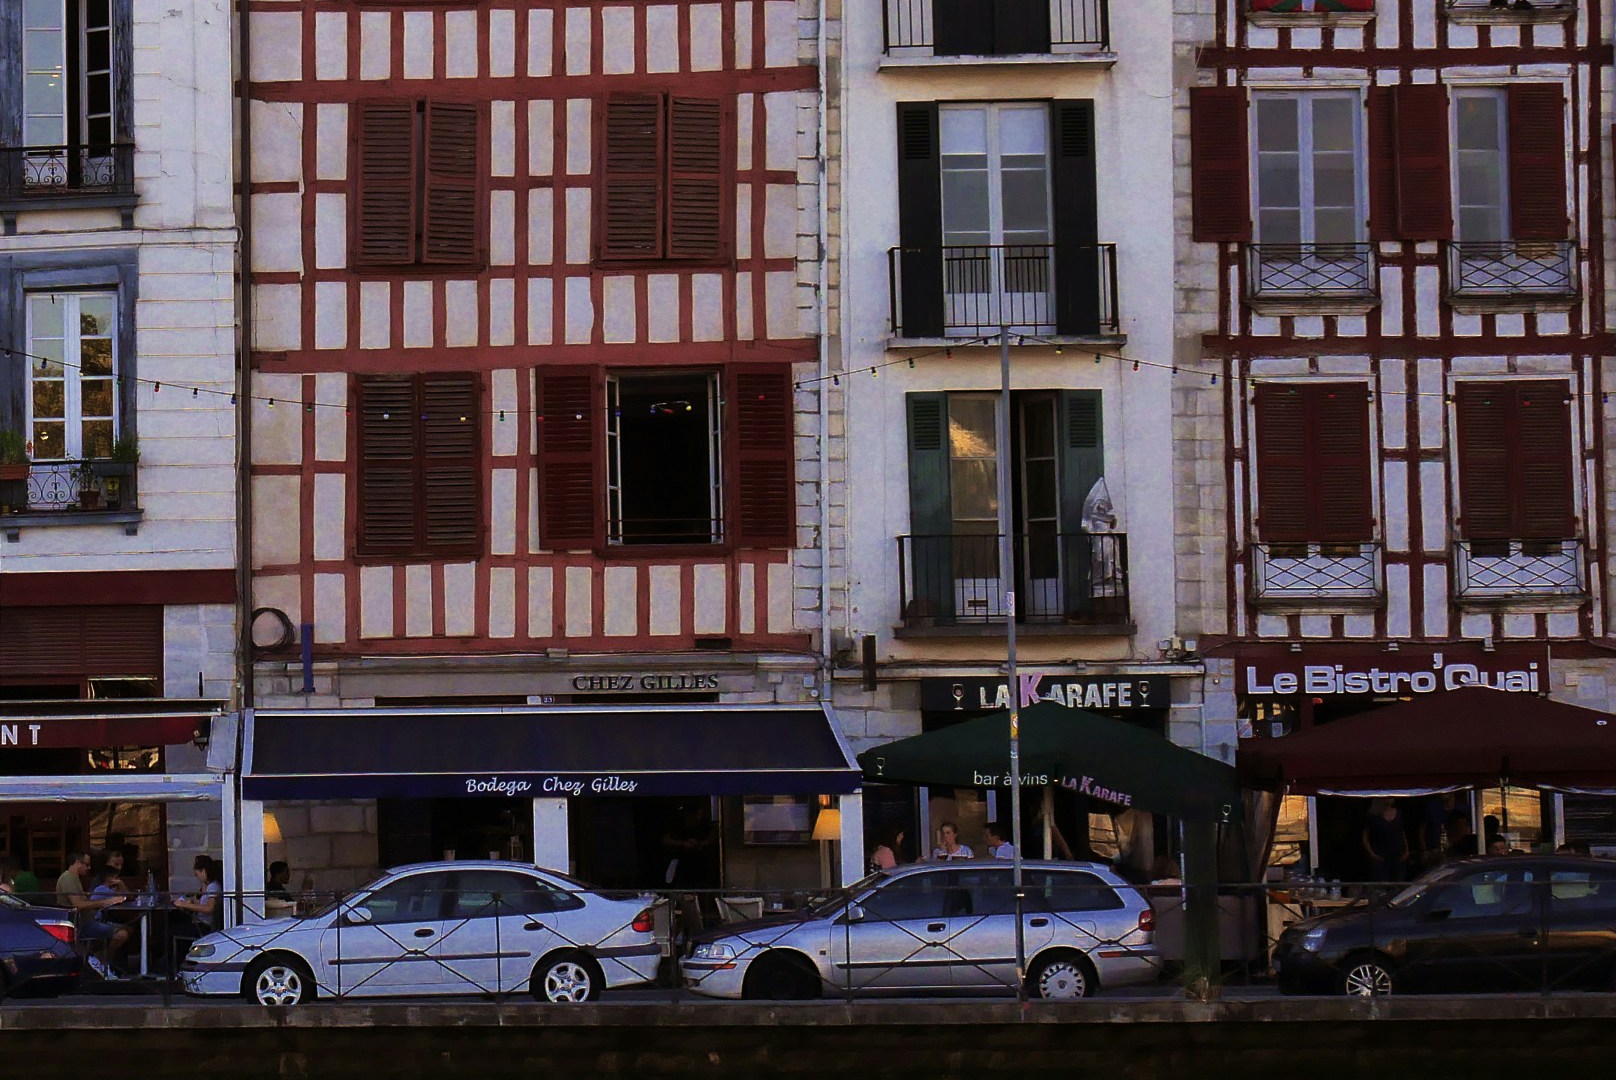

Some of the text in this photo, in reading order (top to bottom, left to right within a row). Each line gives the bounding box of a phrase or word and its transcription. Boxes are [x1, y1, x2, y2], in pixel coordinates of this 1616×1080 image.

[572, 673, 719, 691] CHEZ GILLES
[1246, 665, 1298, 694] Le
[979, 684, 1011, 709] LA
[465, 776, 638, 796] Bodega Chez Gilles
[973, 770, 999, 785] bar
[1018, 773, 1048, 786] vins
